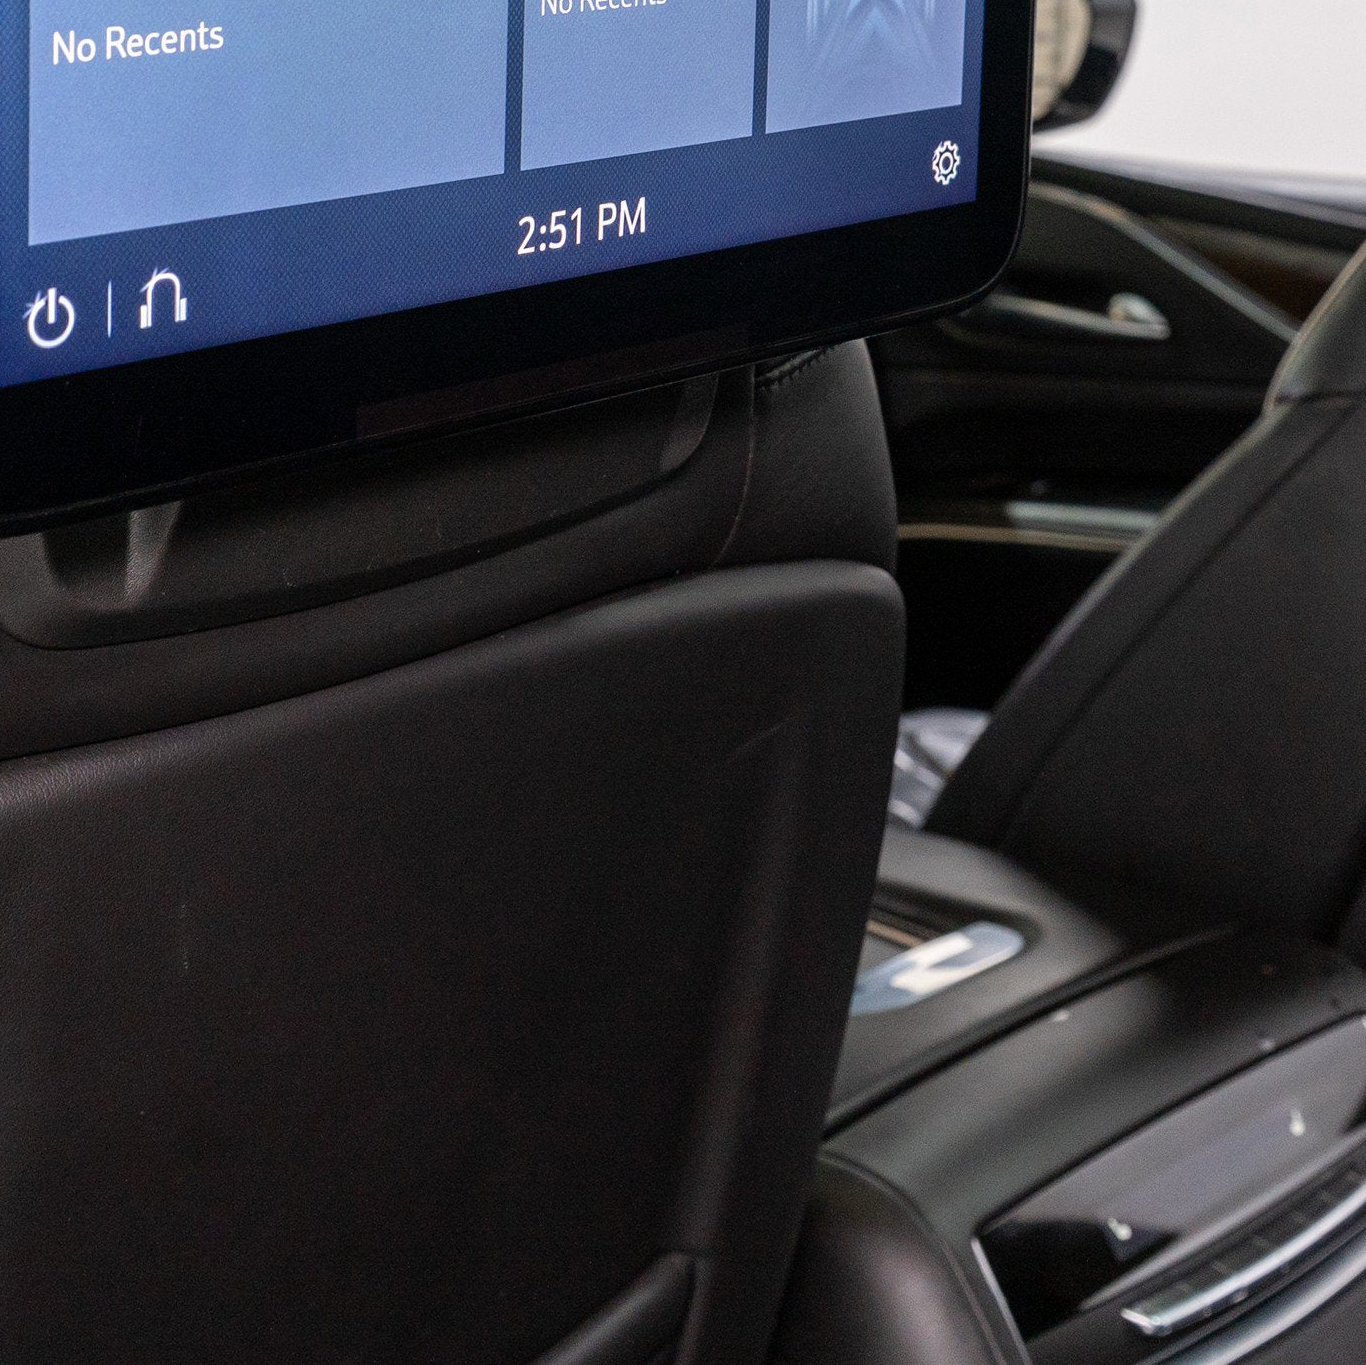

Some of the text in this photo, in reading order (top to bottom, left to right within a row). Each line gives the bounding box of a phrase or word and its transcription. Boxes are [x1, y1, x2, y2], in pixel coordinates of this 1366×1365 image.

[52, 21, 224, 66] No Recents
[517, 196, 646, 255] 2:51 PM
